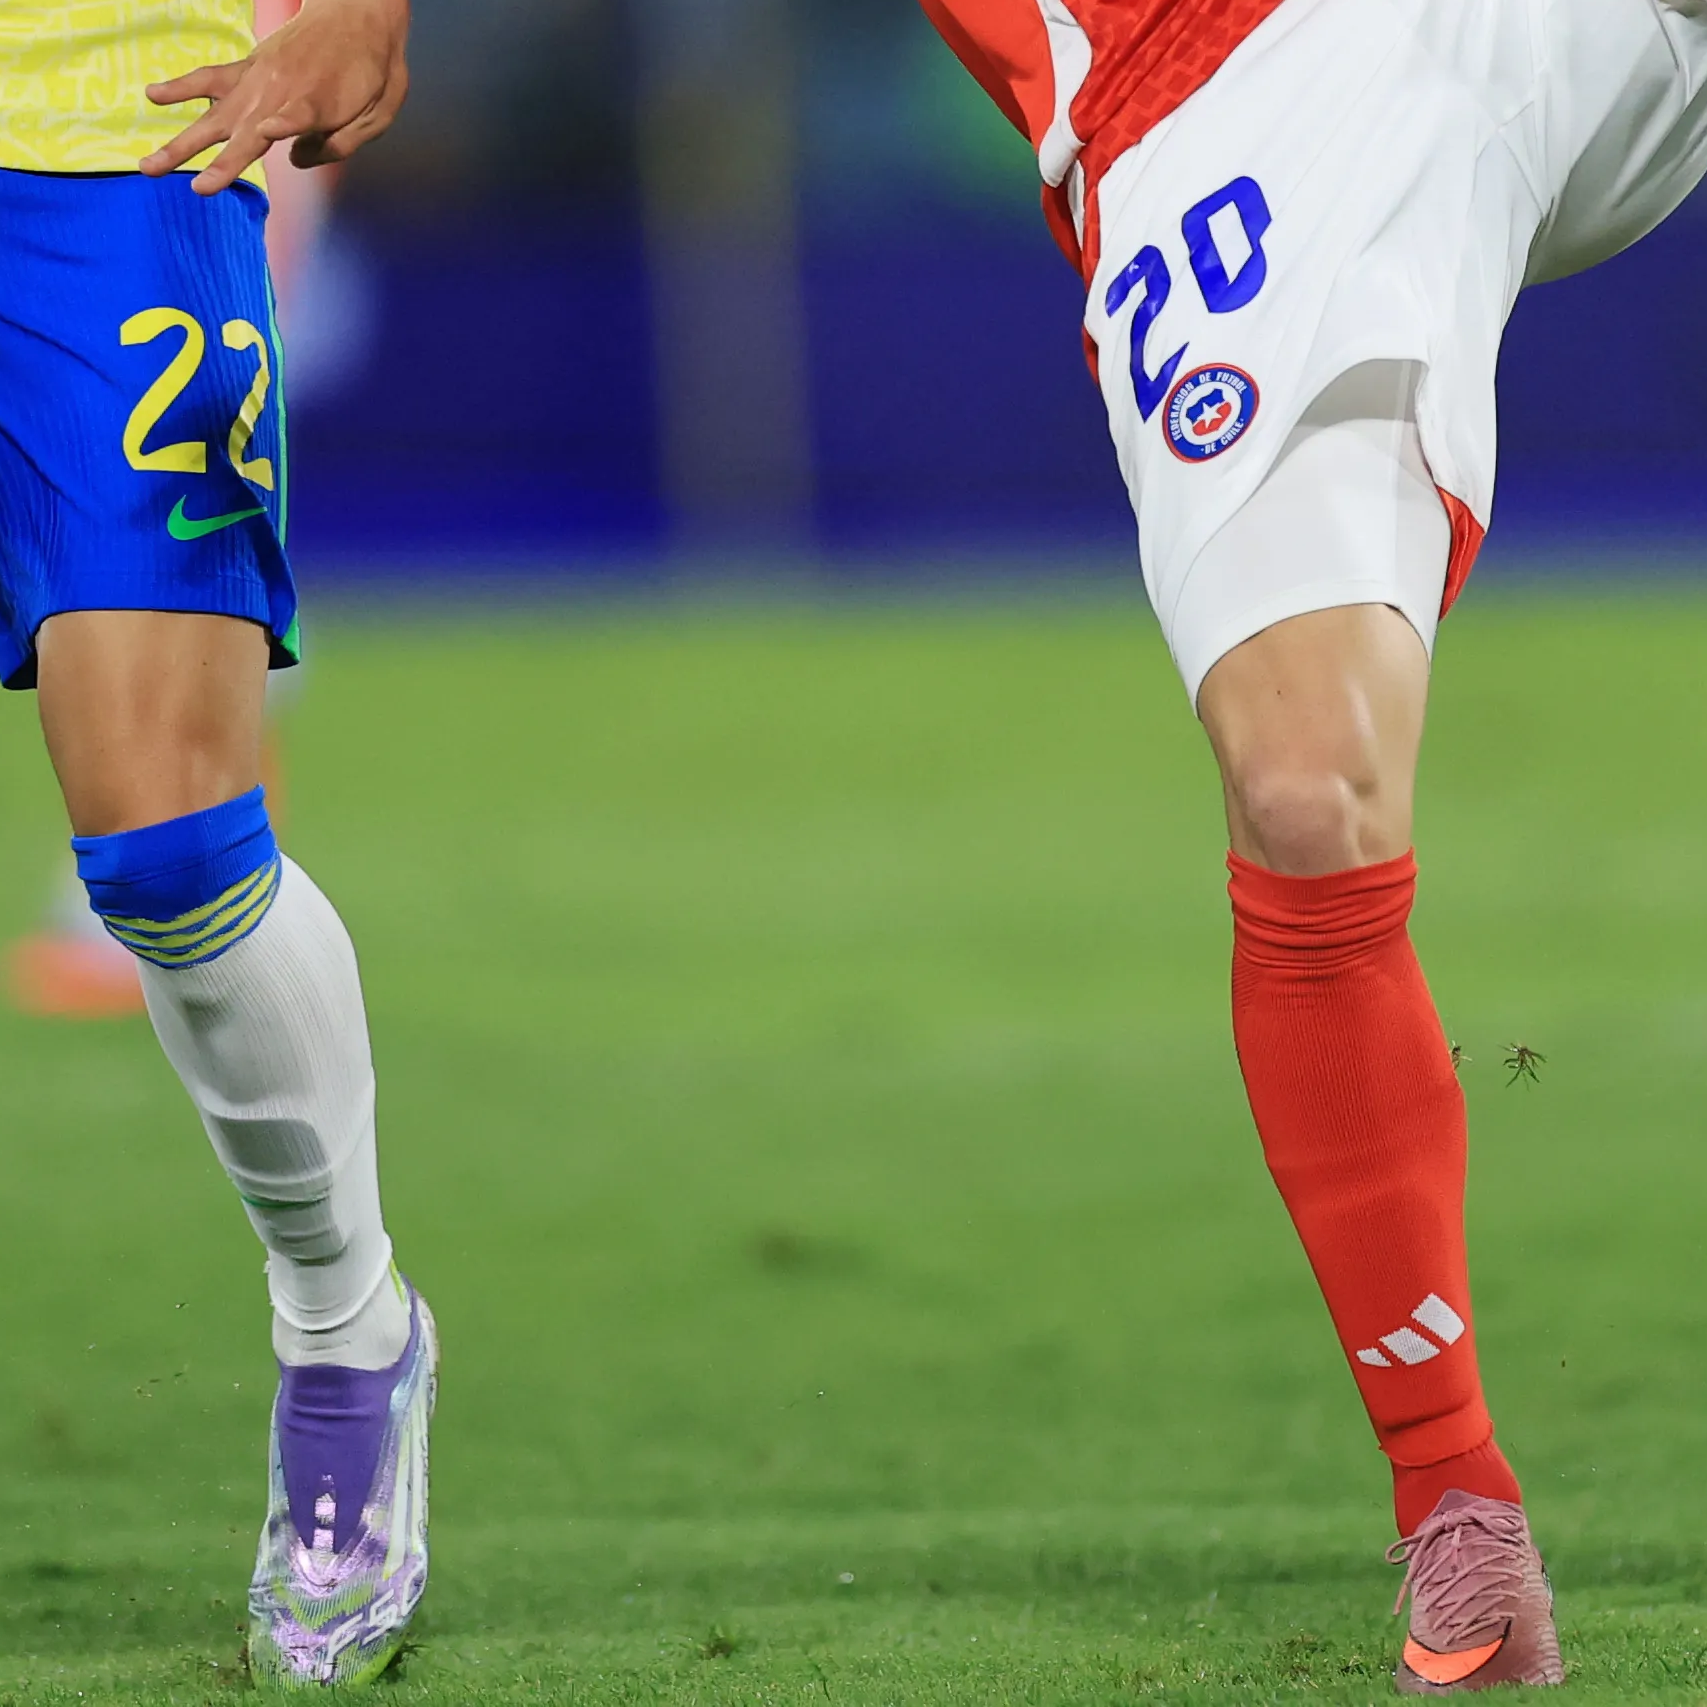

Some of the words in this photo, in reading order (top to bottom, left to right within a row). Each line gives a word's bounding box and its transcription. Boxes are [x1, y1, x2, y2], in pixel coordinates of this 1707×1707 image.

[1105, 175, 1272, 424] 20
[120, 306, 275, 492] 22
[1198, 372, 1212, 384] DE
[1216, 371, 1248, 394] FUTBOL
[1204, 442, 1217, 454] DE
[1220, 420, 1244, 446] CHILE
[322, 1560, 427, 1681] F50
